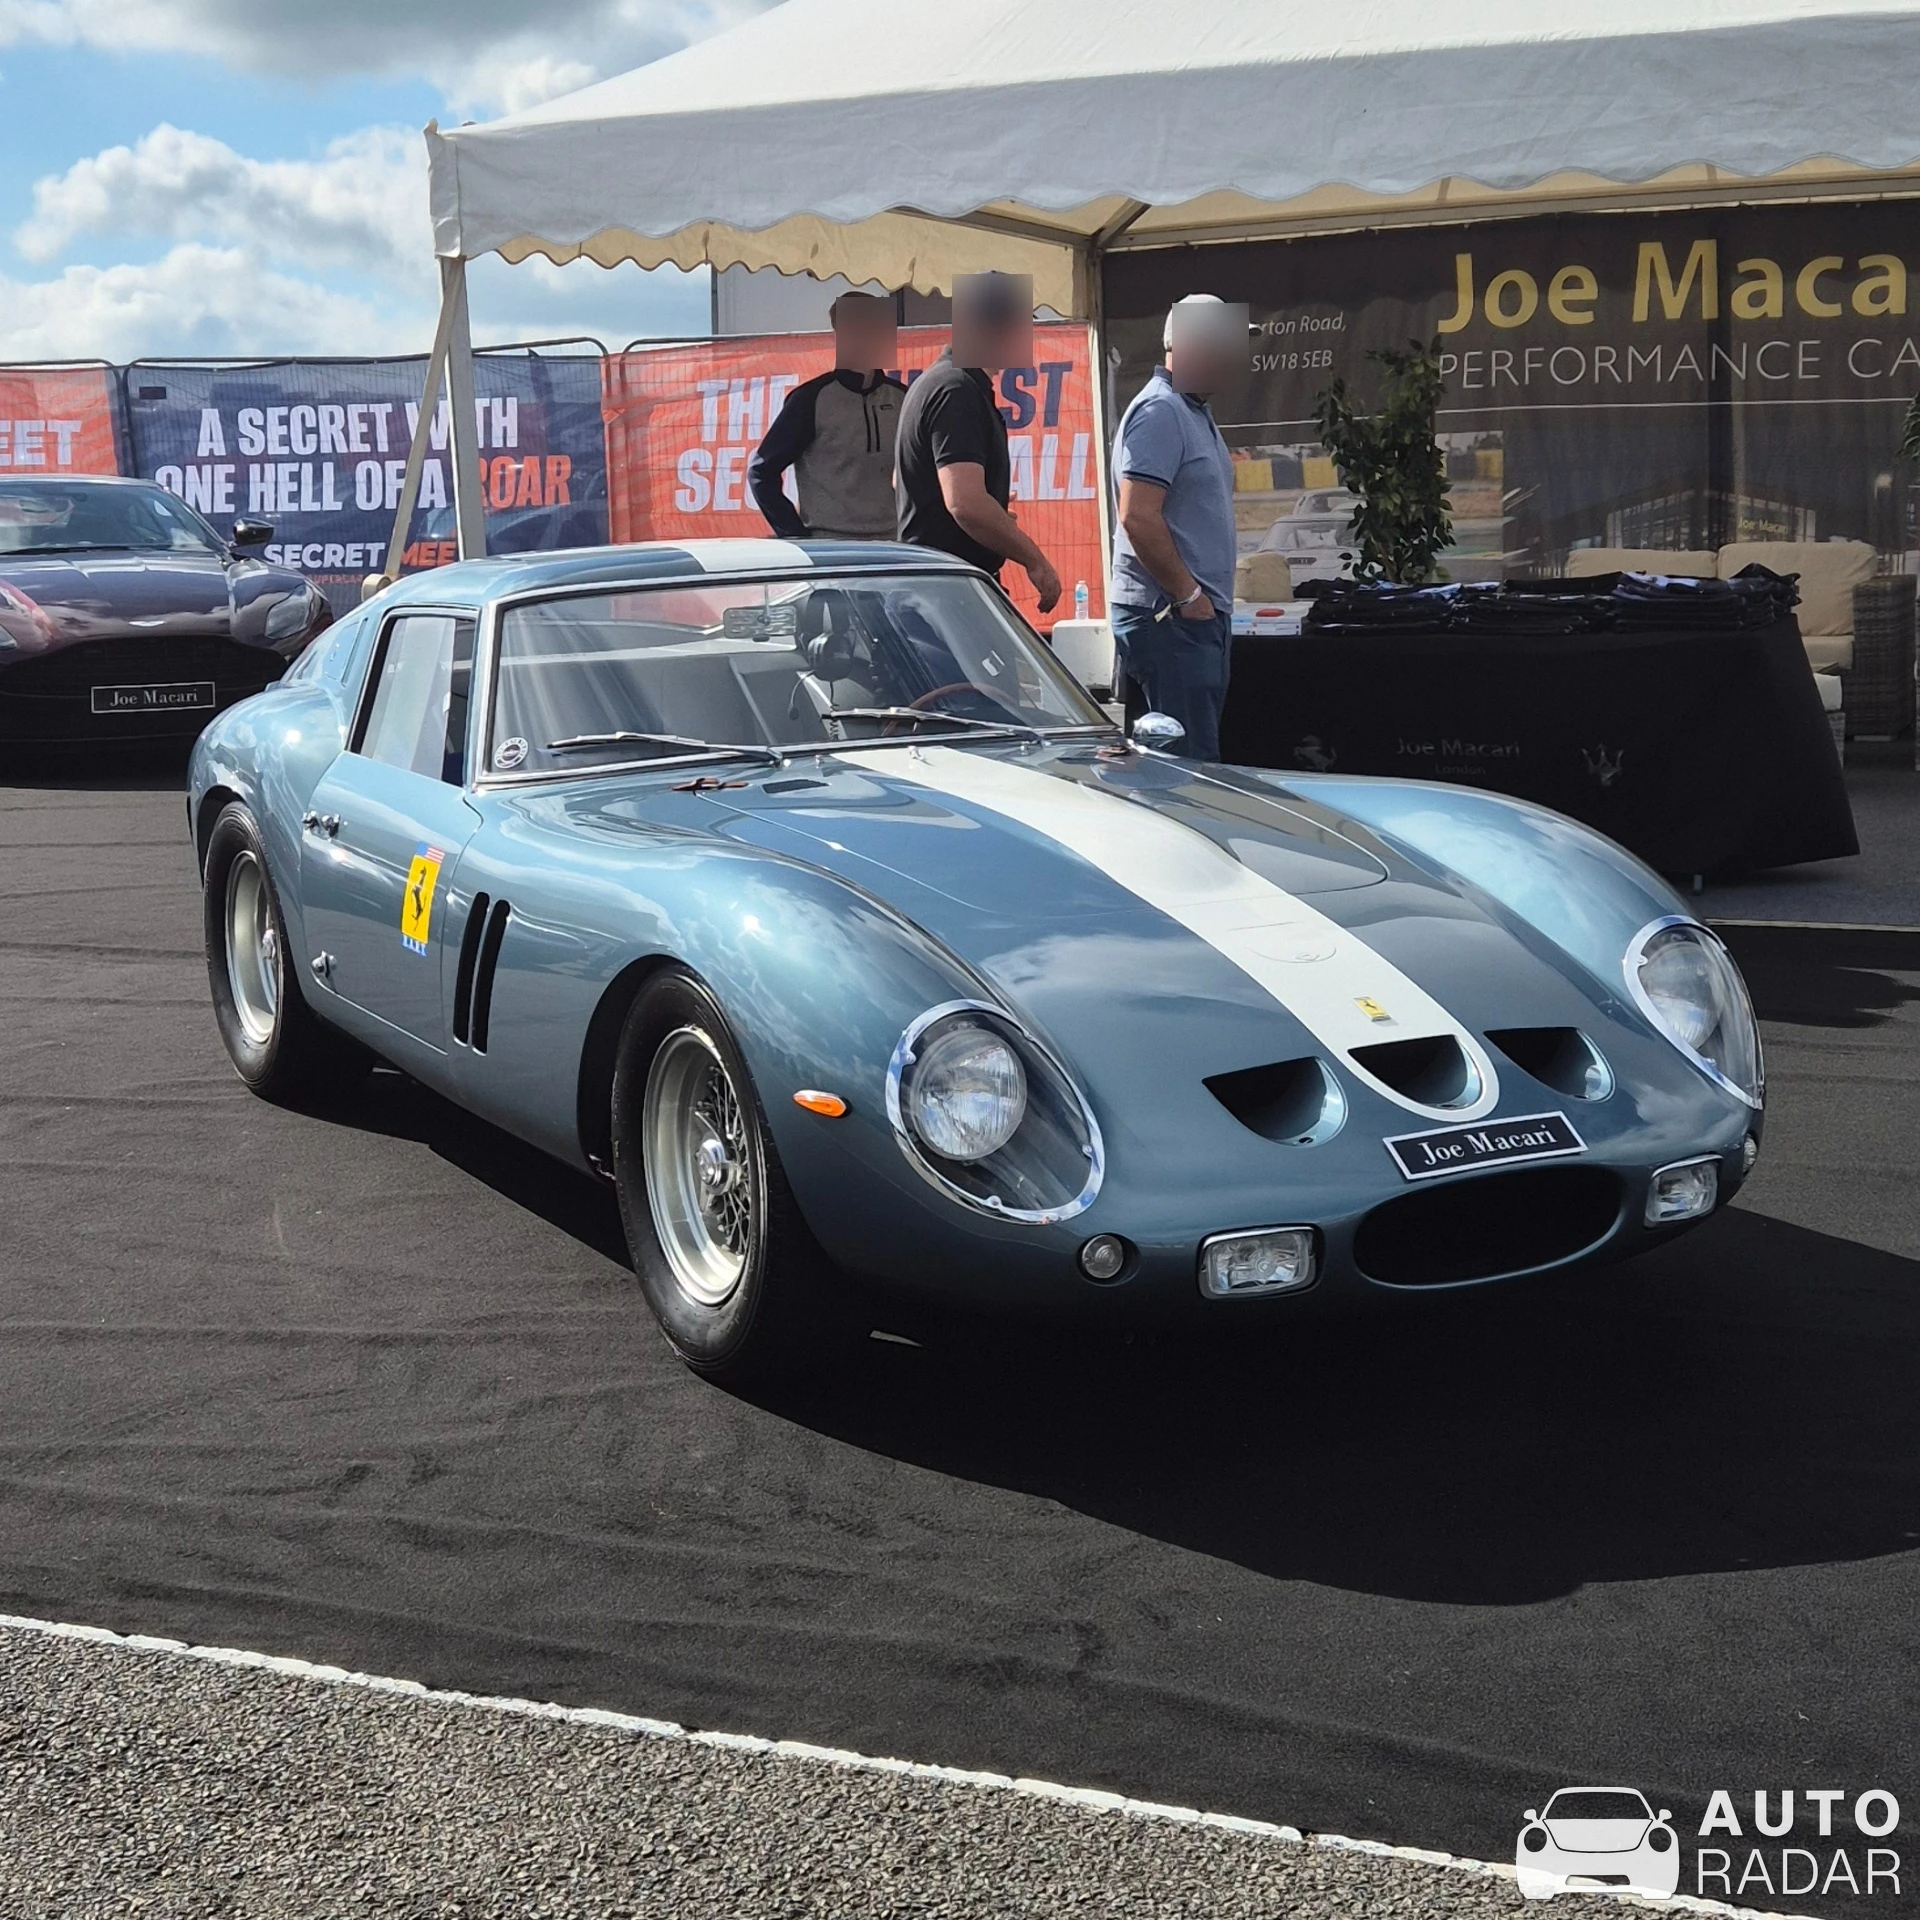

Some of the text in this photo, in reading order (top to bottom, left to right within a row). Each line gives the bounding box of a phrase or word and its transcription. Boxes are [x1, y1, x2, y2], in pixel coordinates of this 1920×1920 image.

[1437, 238, 1908, 334] Joe Maca
[1257, 311, 1347, 336] rton Road,
[1250, 349, 1334, 373] SW18 5EB
[1438, 338, 1823, 390] PERFORMANCE
[197, 396, 518, 457] A SECRET WTH
[155, 463, 236, 515] ONE
[248, 461, 344, 513] HELL
[355, 459, 407, 512] OF
[417, 458, 448, 510] A
[263, 540, 458, 569] SECRET MEE
[109, 687, 199, 708] Joe Macari
[1396, 736, 1521, 759] Joe Macari
[1417, 1123, 1558, 1167] Joe Macari
